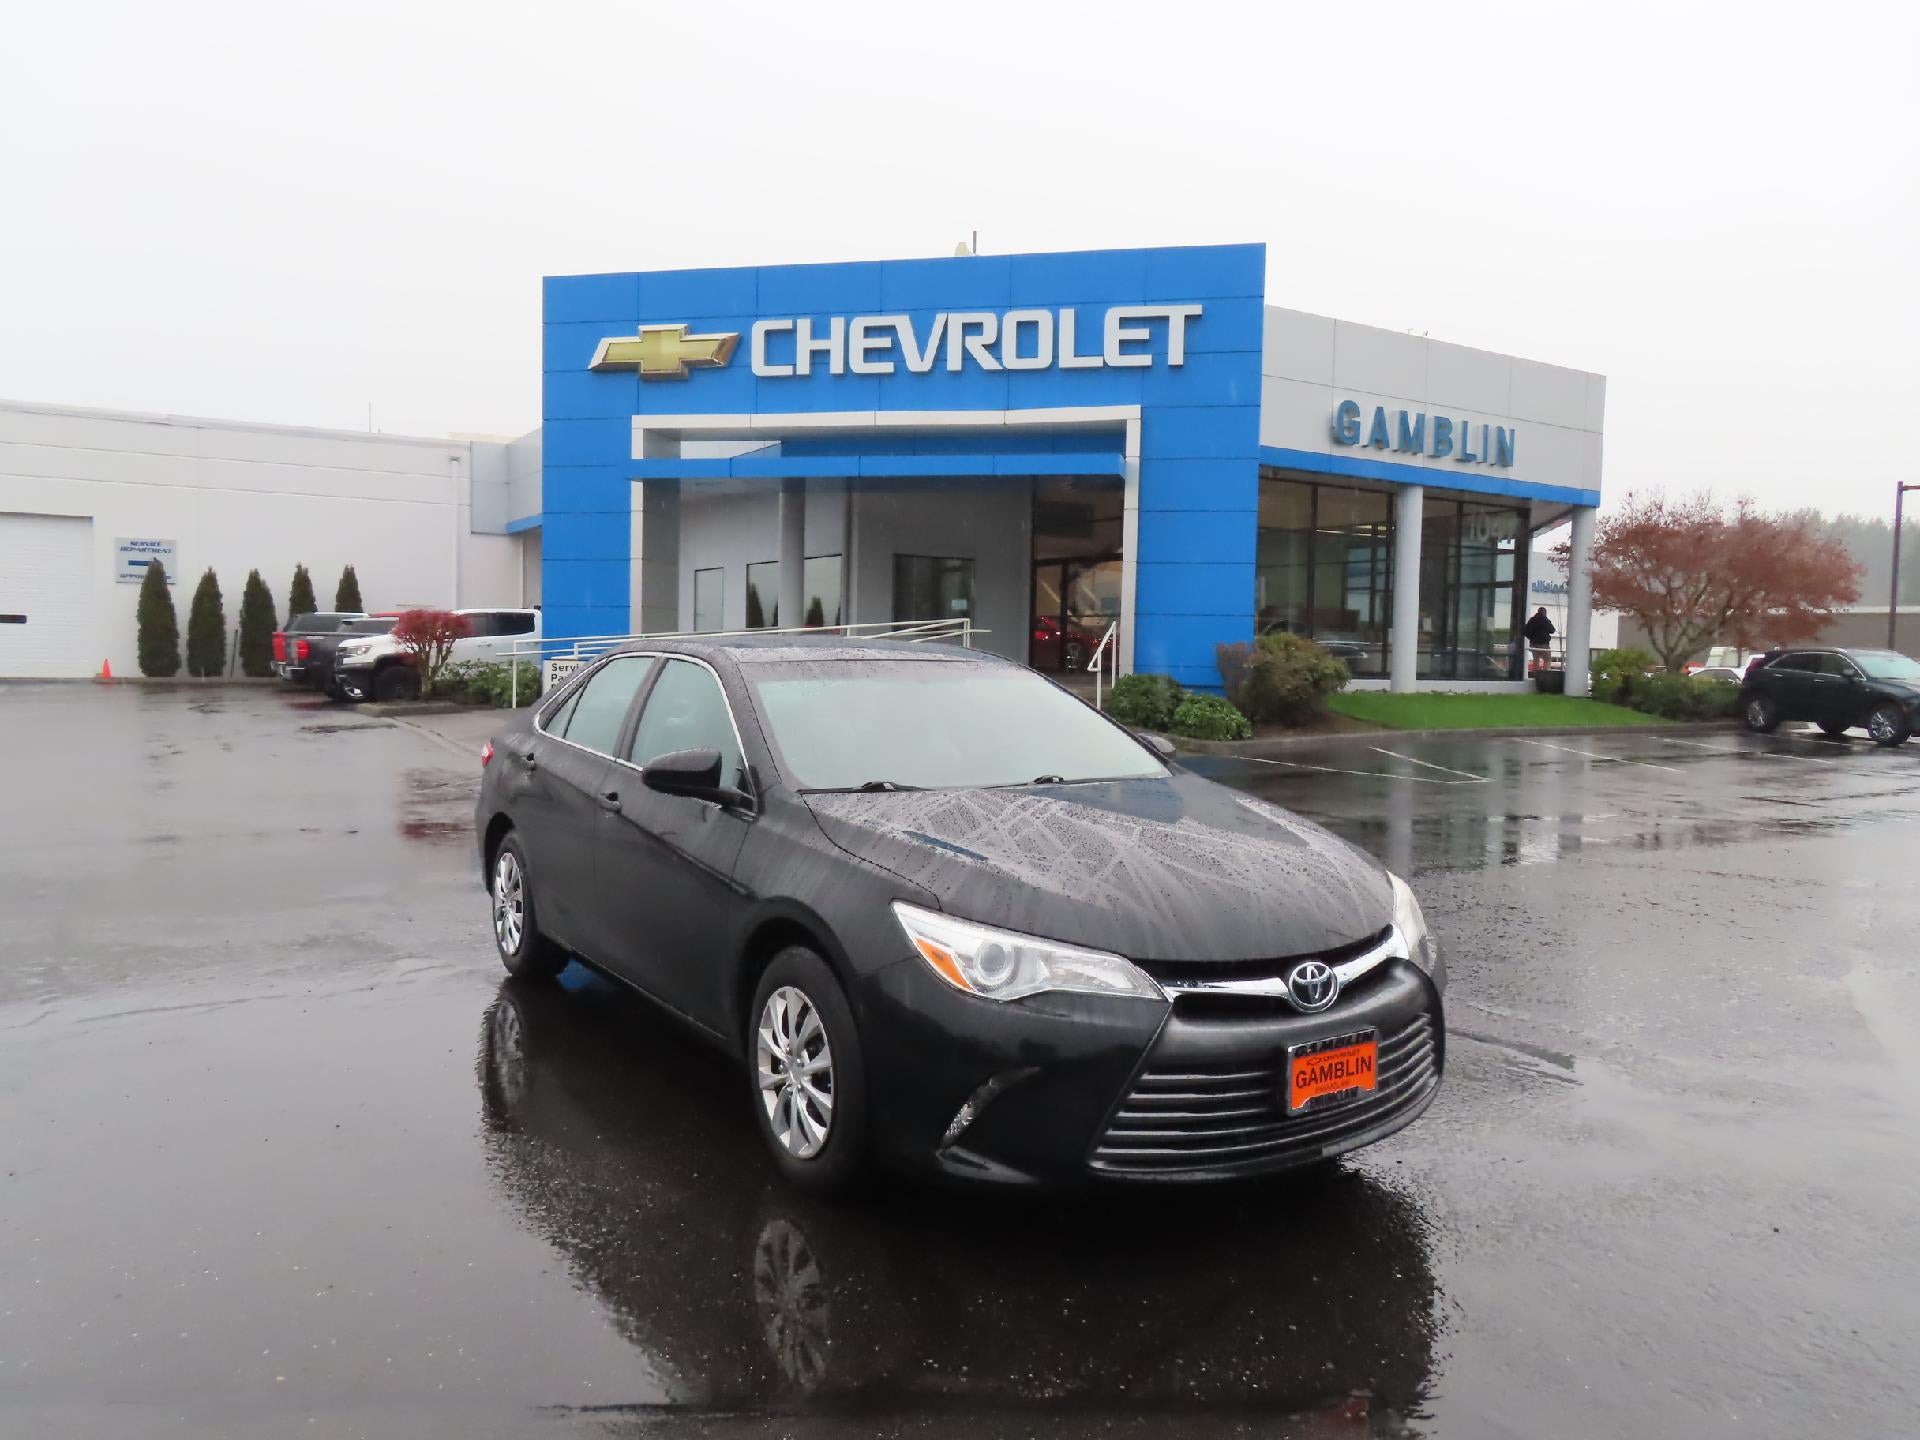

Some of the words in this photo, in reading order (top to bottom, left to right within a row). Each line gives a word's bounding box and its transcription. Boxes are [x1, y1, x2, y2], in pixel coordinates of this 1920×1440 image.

[751, 304, 1203, 377] CHEVROLET
[1335, 399, 1516, 468] GAMBLIN
[551, 663, 580, 672] Servi
[1296, 1056, 1372, 1088] GAMBLIN
